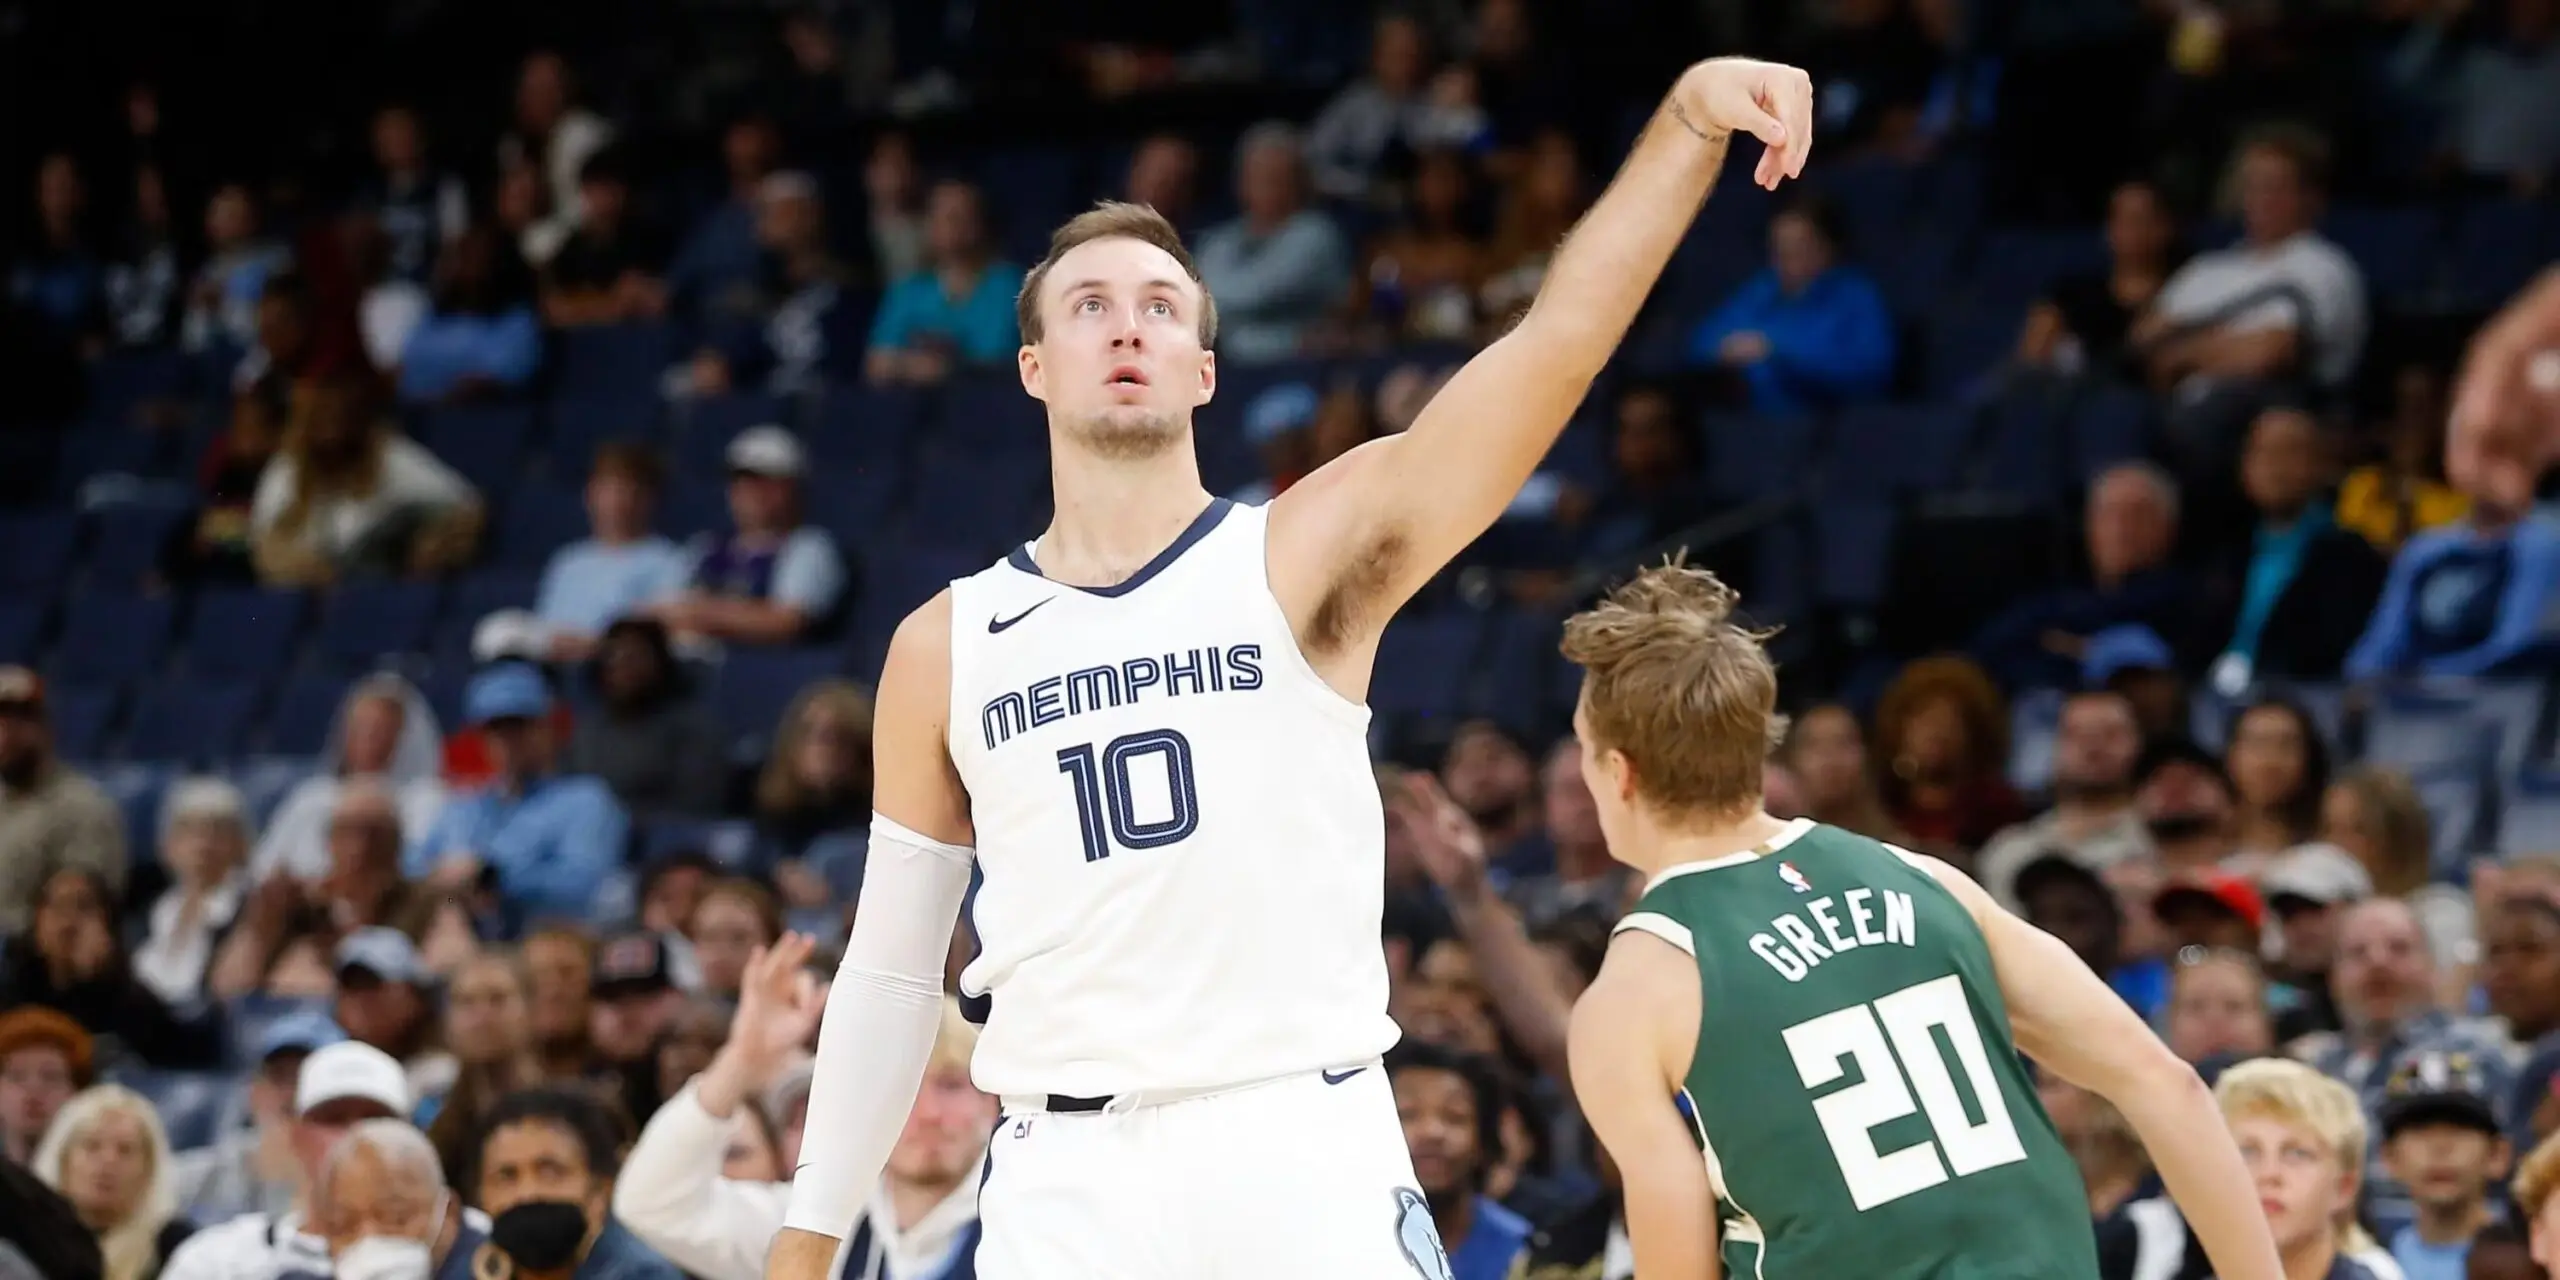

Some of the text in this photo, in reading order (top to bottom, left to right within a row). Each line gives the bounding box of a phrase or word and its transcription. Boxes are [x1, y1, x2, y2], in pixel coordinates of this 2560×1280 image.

[982, 643, 1263, 750] MEMPHIS
[1056, 728, 1199, 862] 10
[1748, 888, 1916, 982] GREEN
[1781, 974, 2028, 1212] 20
